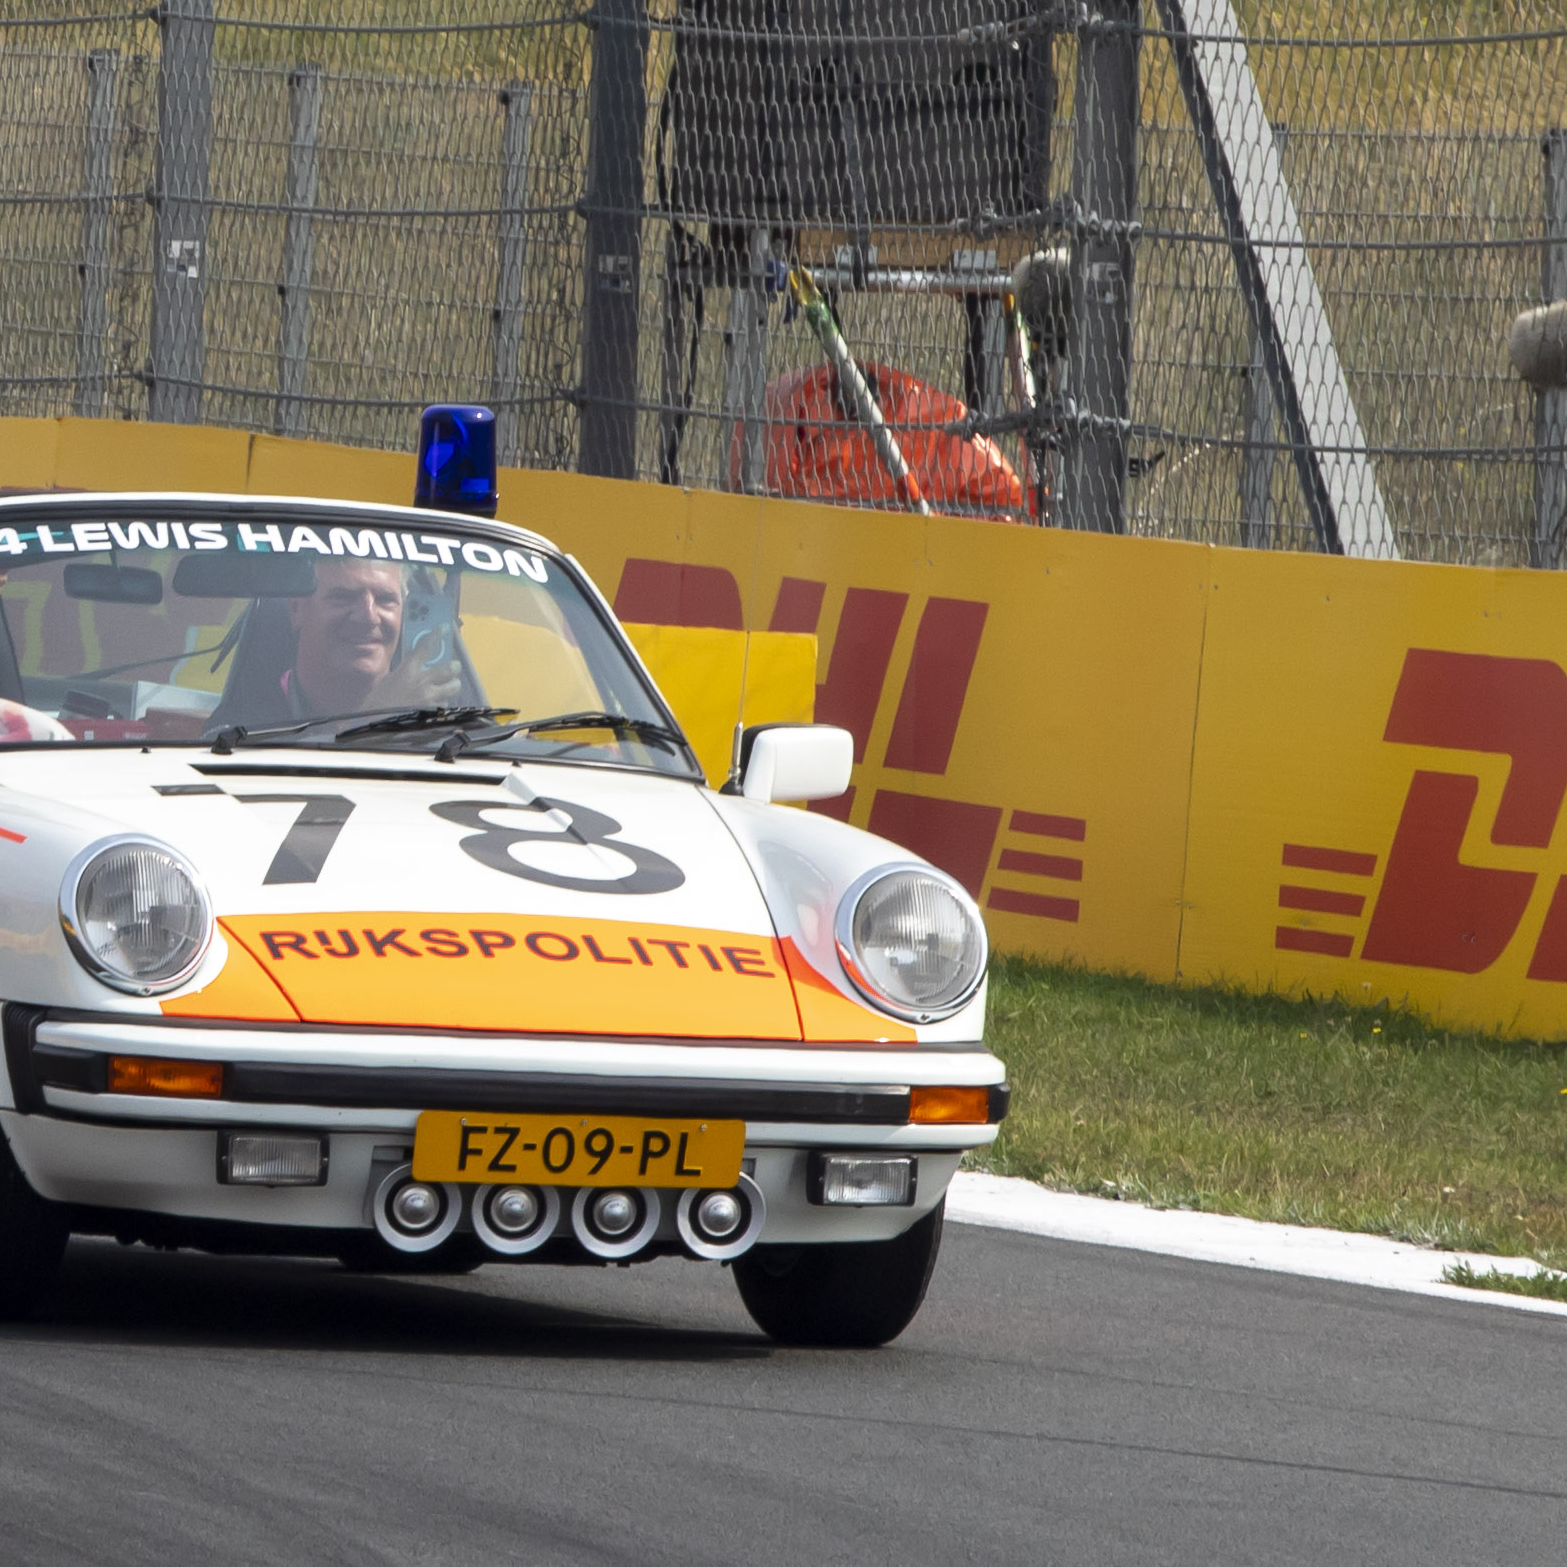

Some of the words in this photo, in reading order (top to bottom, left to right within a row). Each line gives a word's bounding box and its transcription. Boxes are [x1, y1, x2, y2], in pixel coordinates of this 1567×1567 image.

[36, 521, 228, 553] LEWIS
[237, 522, 549, 584] HAMILTON
[151, 784, 686, 895] 78
[259, 927, 777, 978] RIJKSPOLITIE
[457, 1125, 704, 1177] FZ-09-PL
